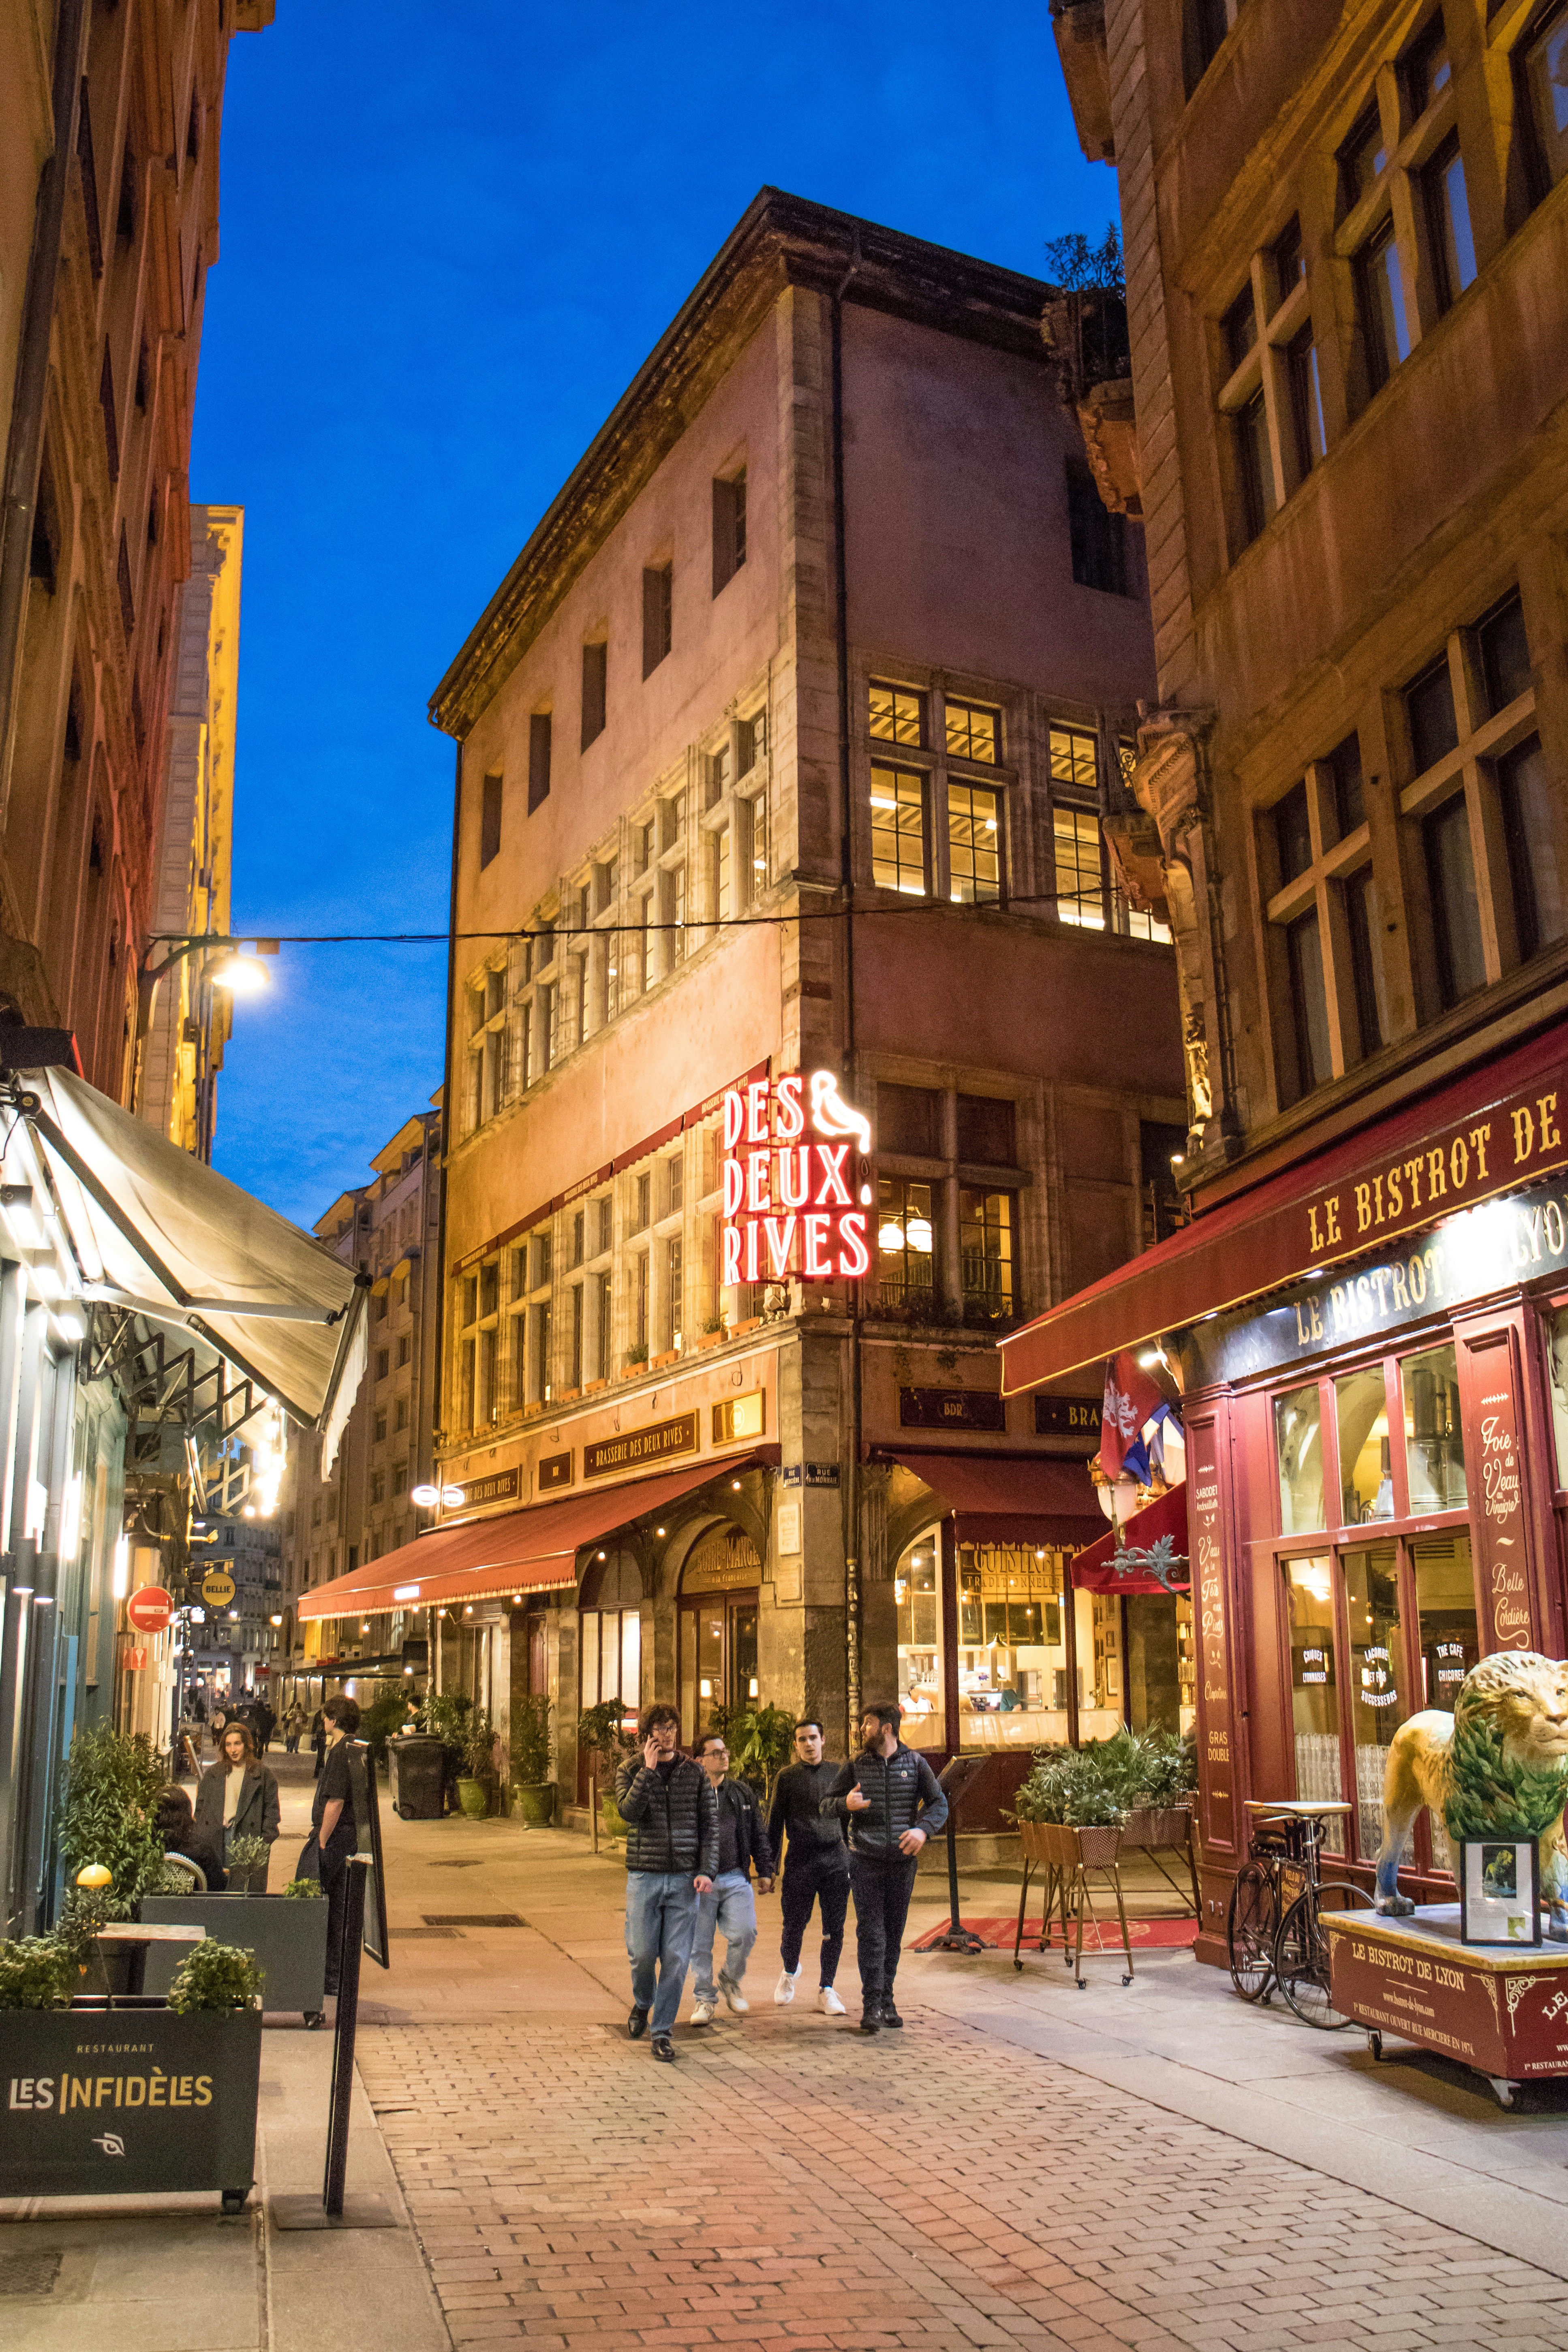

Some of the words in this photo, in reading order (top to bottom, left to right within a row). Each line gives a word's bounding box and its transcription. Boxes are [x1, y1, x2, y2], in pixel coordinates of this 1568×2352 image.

[724, 1077, 803, 1150] DES
[724, 1144, 852, 1218] DEUX
[1307, 1195, 1342, 1253] LE
[1354, 1123, 1491, 1233] BISTROT
[1510, 1092, 1562, 1164] DE
[724, 1213, 870, 1287] RIVES
[1294, 1296, 1323, 1345] LE
[1330, 1245, 1445, 1333] BISTROT
[944, 1403, 962, 1416] BDR
[597, 1443, 627, 1467] BRASSERIE
[630, 1439, 642, 1457] DES
[644, 1433, 660, 1454] DEUX
[663, 1425, 682, 1448] RIVES
[1481, 1416, 1511, 1457] Foie
[1505, 1452, 1514, 1467] de
[484, 1482, 496, 1497] DEUX
[498, 1477, 510, 1494] RIVES
[1196, 1485, 1217, 1499] SABODET
[1483, 1458, 1519, 1499] Veau
[1485, 1490, 1519, 1524] Vinaigre
[1198, 1535, 1220, 1565] Veau
[1492, 1563, 1524, 1593] Belle
[1495, 1597, 1530, 1649] Cordière
[1364, 1647, 1388, 1663] LACOMBE
[1375, 1671, 1386, 1683] FS
[1361, 1689, 1397, 1707] SUCCESSEURS
[1209, 1730, 1228, 1745] GRAS
[1208, 1748, 1230, 1762] DOUBLE
[1352, 1942, 1365, 1960] LE
[1367, 1946, 1414, 1975] BISTROT
[1416, 1959, 1433, 1980] DE
[1434, 1965, 1466, 1992] LYON
[1358, 2003, 1389, 2024] RESTAURANT
[1390, 2014, 1411, 2031] OUVERT
[1412, 2021, 1423, 2036] RUE
[1451, 2036, 1460, 2050] EN
[77, 2043, 155, 2054] RESTAURANT
[9, 2077, 54, 2109] LES
[59, 2066, 213, 2115] INFIDÈLES
